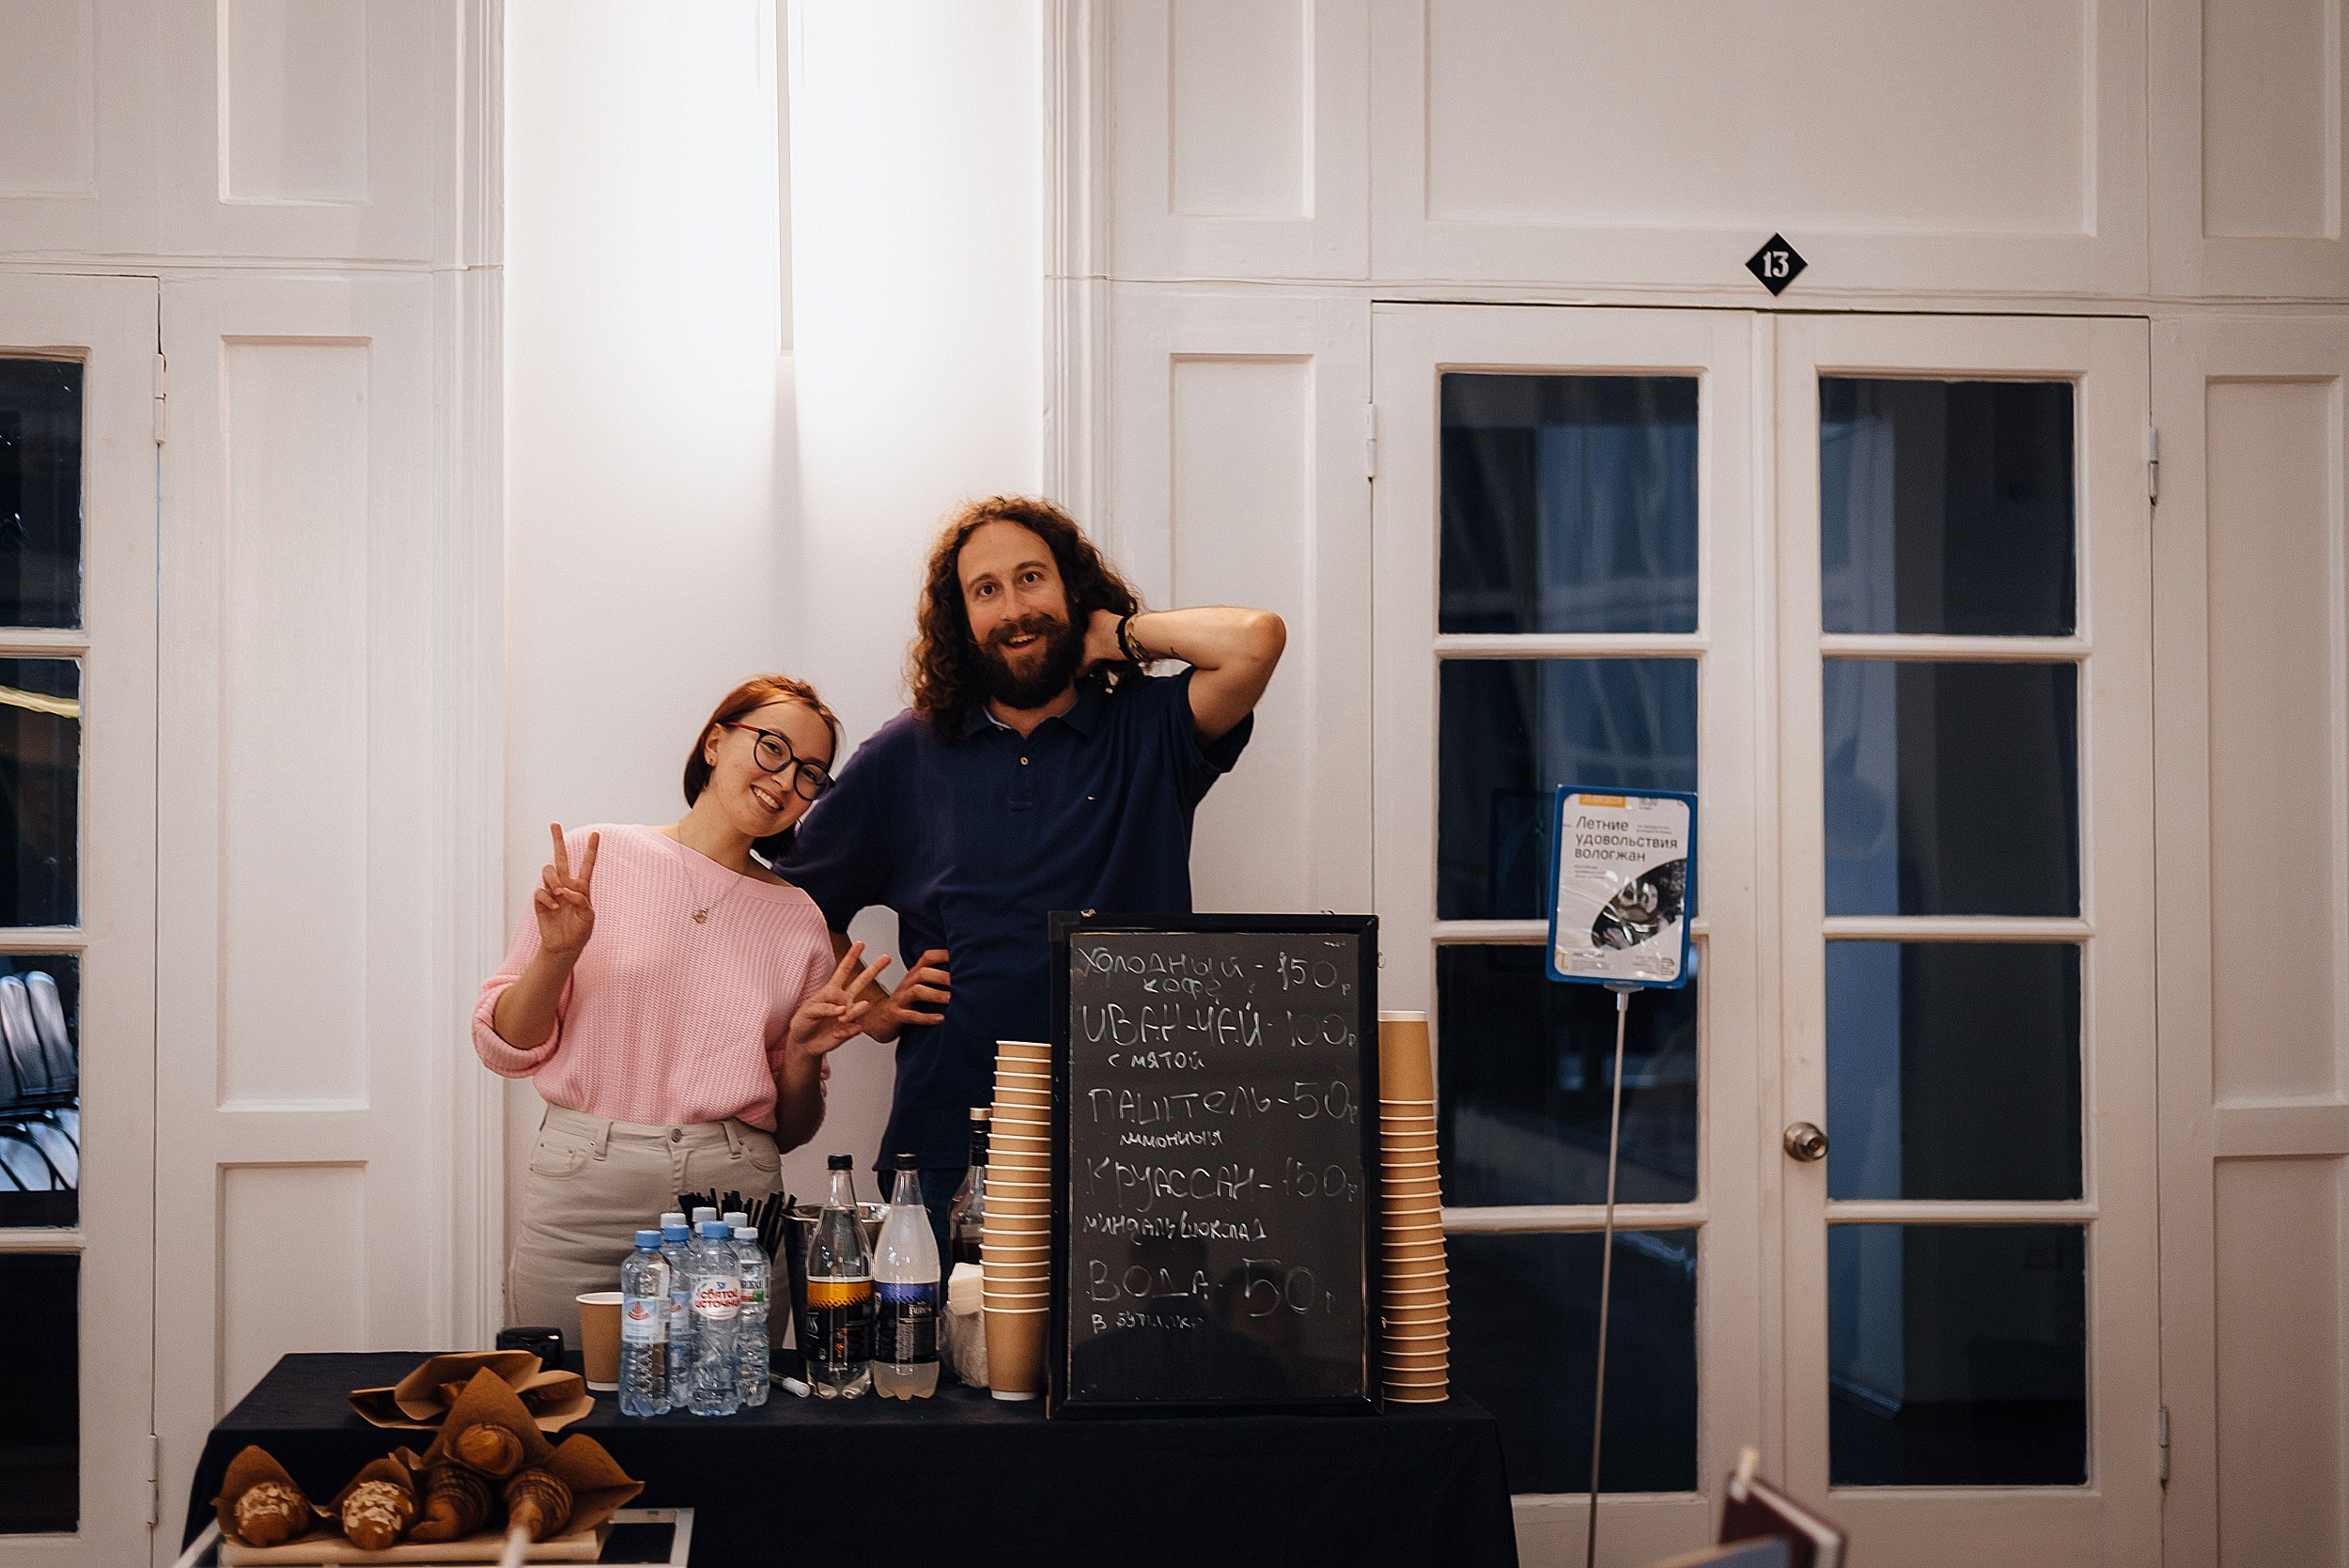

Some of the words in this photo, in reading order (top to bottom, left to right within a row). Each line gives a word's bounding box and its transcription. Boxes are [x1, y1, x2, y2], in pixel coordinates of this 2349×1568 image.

[1763, 251, 1790, 278] 13
[1576, 815, 1628, 831] Летние
[1575, 833, 1678, 849] удовольствия
[1574, 848, 1646, 862] вологжан
[1085, 1259, 1209, 1301] ВОДА
